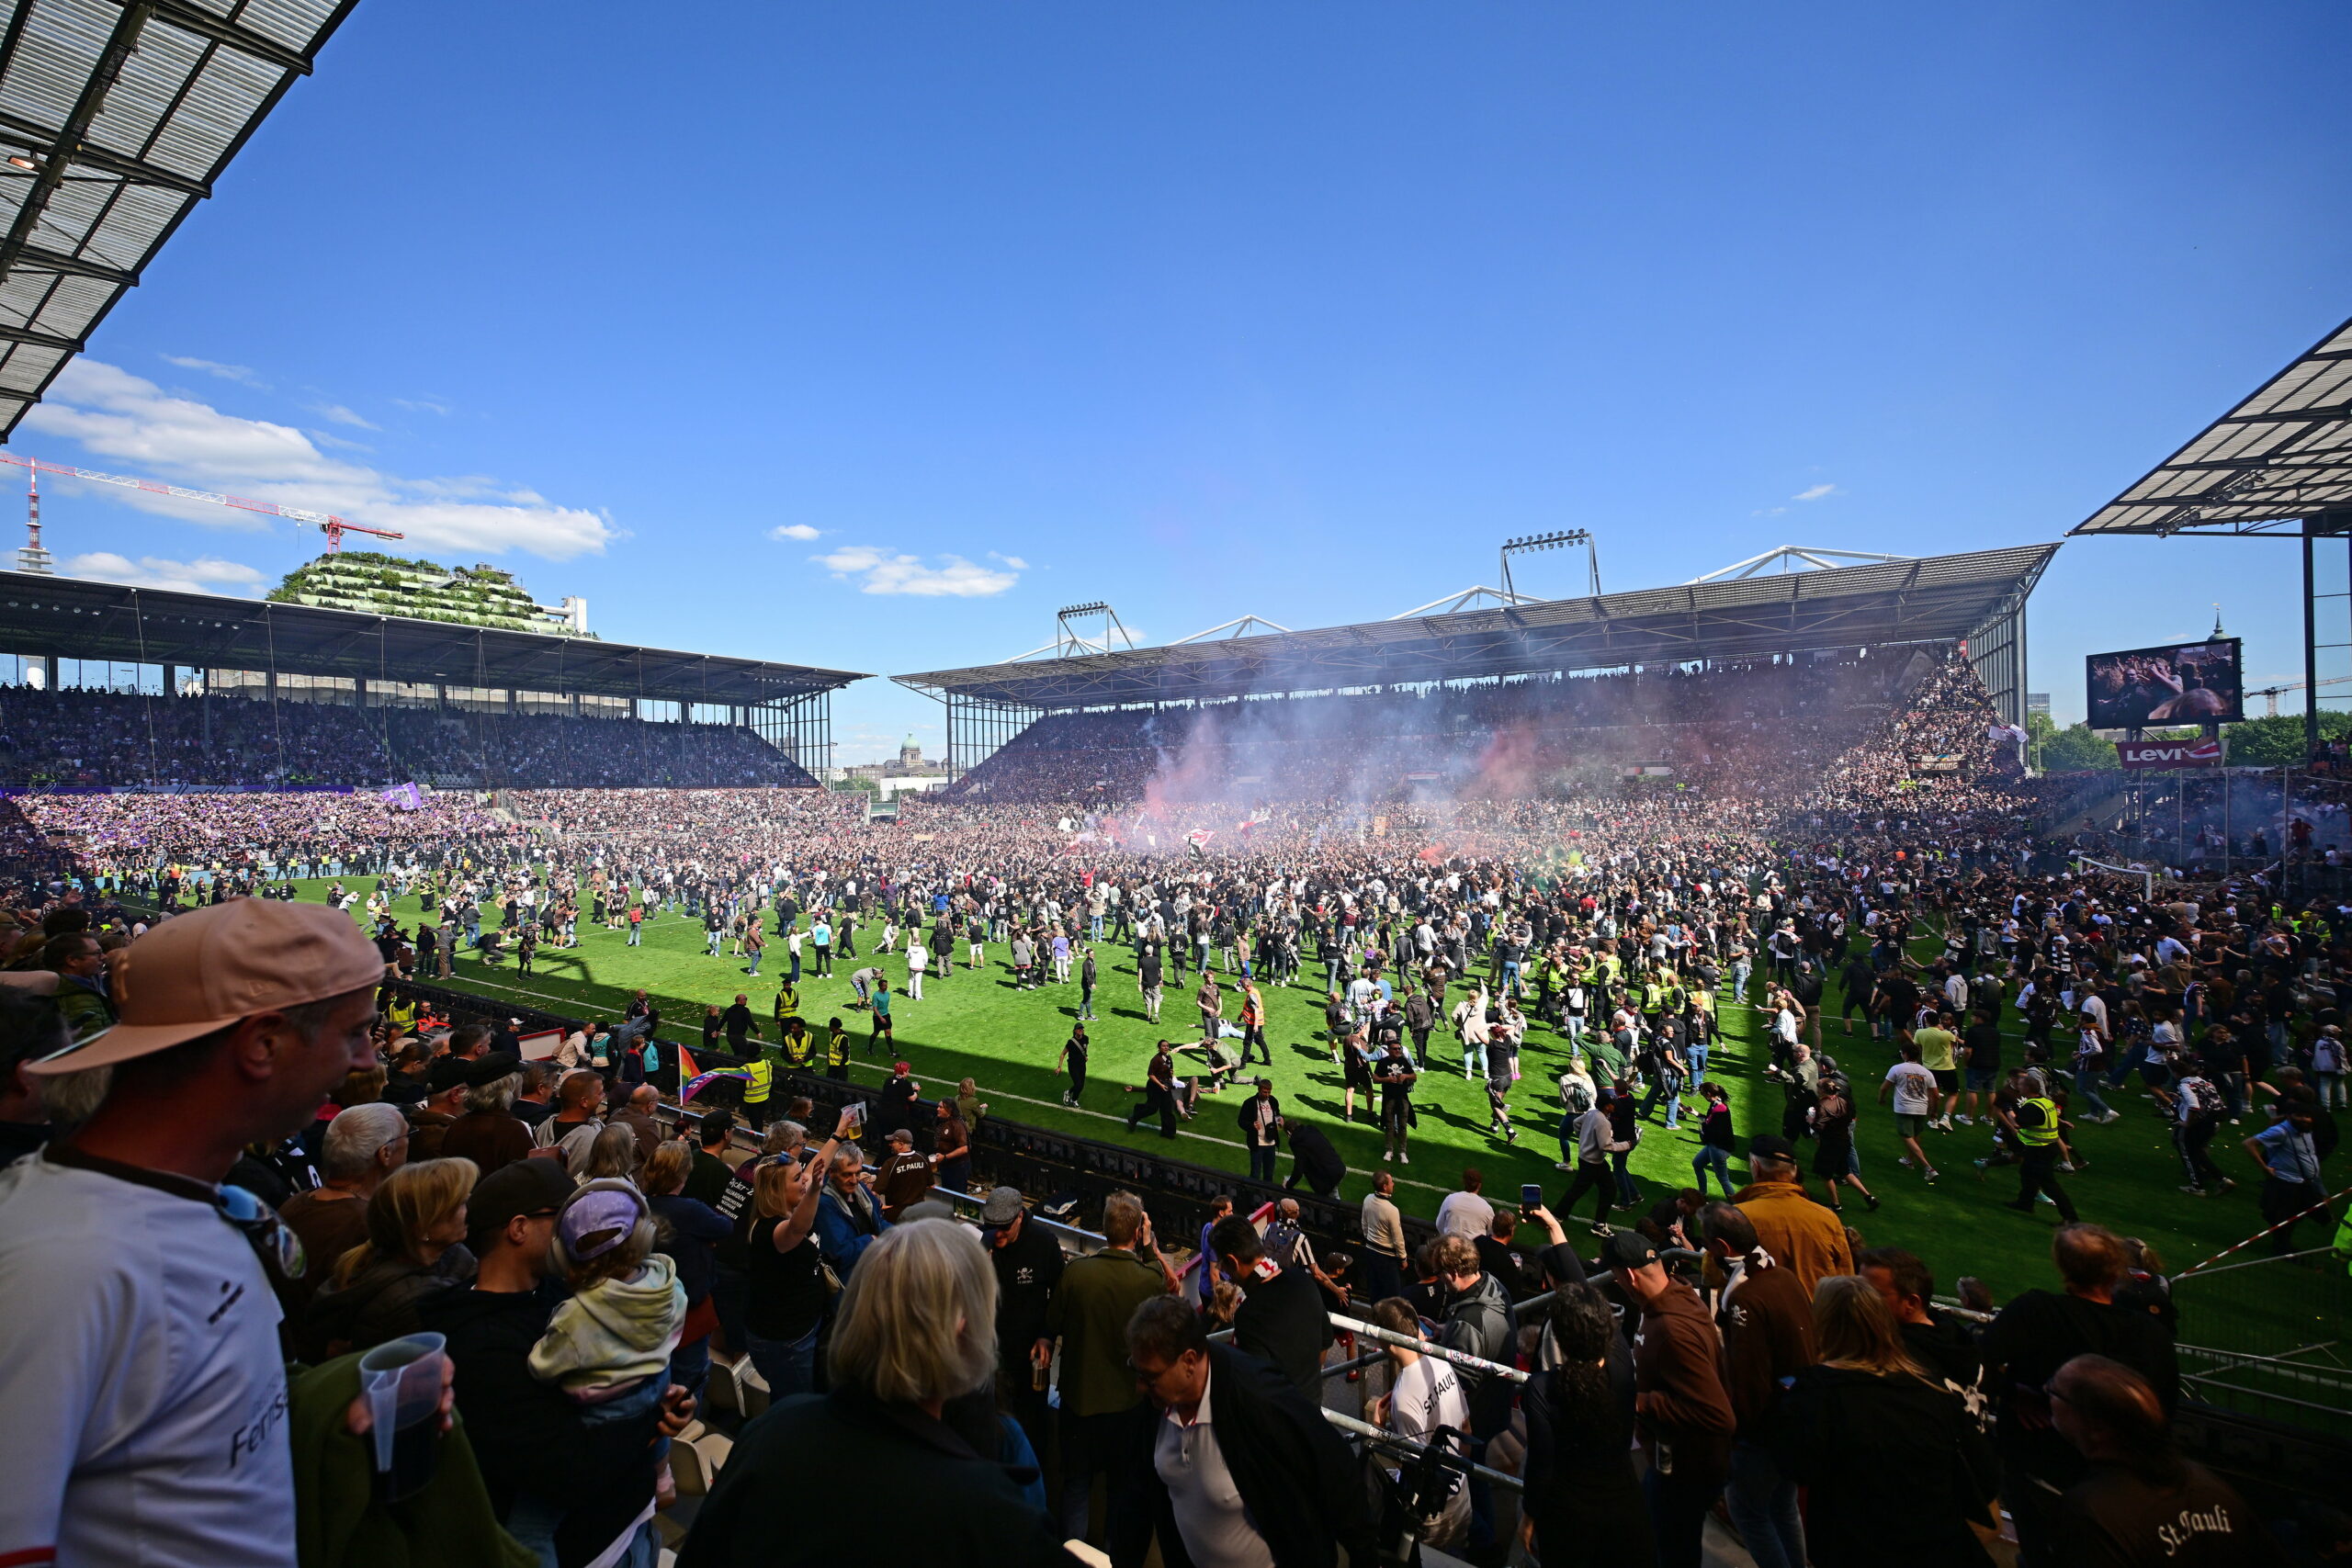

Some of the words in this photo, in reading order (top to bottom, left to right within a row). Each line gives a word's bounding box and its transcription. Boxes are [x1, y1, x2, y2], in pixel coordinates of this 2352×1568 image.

[906, 1162, 924, 1171] PAULI
[1423, 1394, 1439, 1416] ST.
[2158, 1522, 2187, 1557] St.
